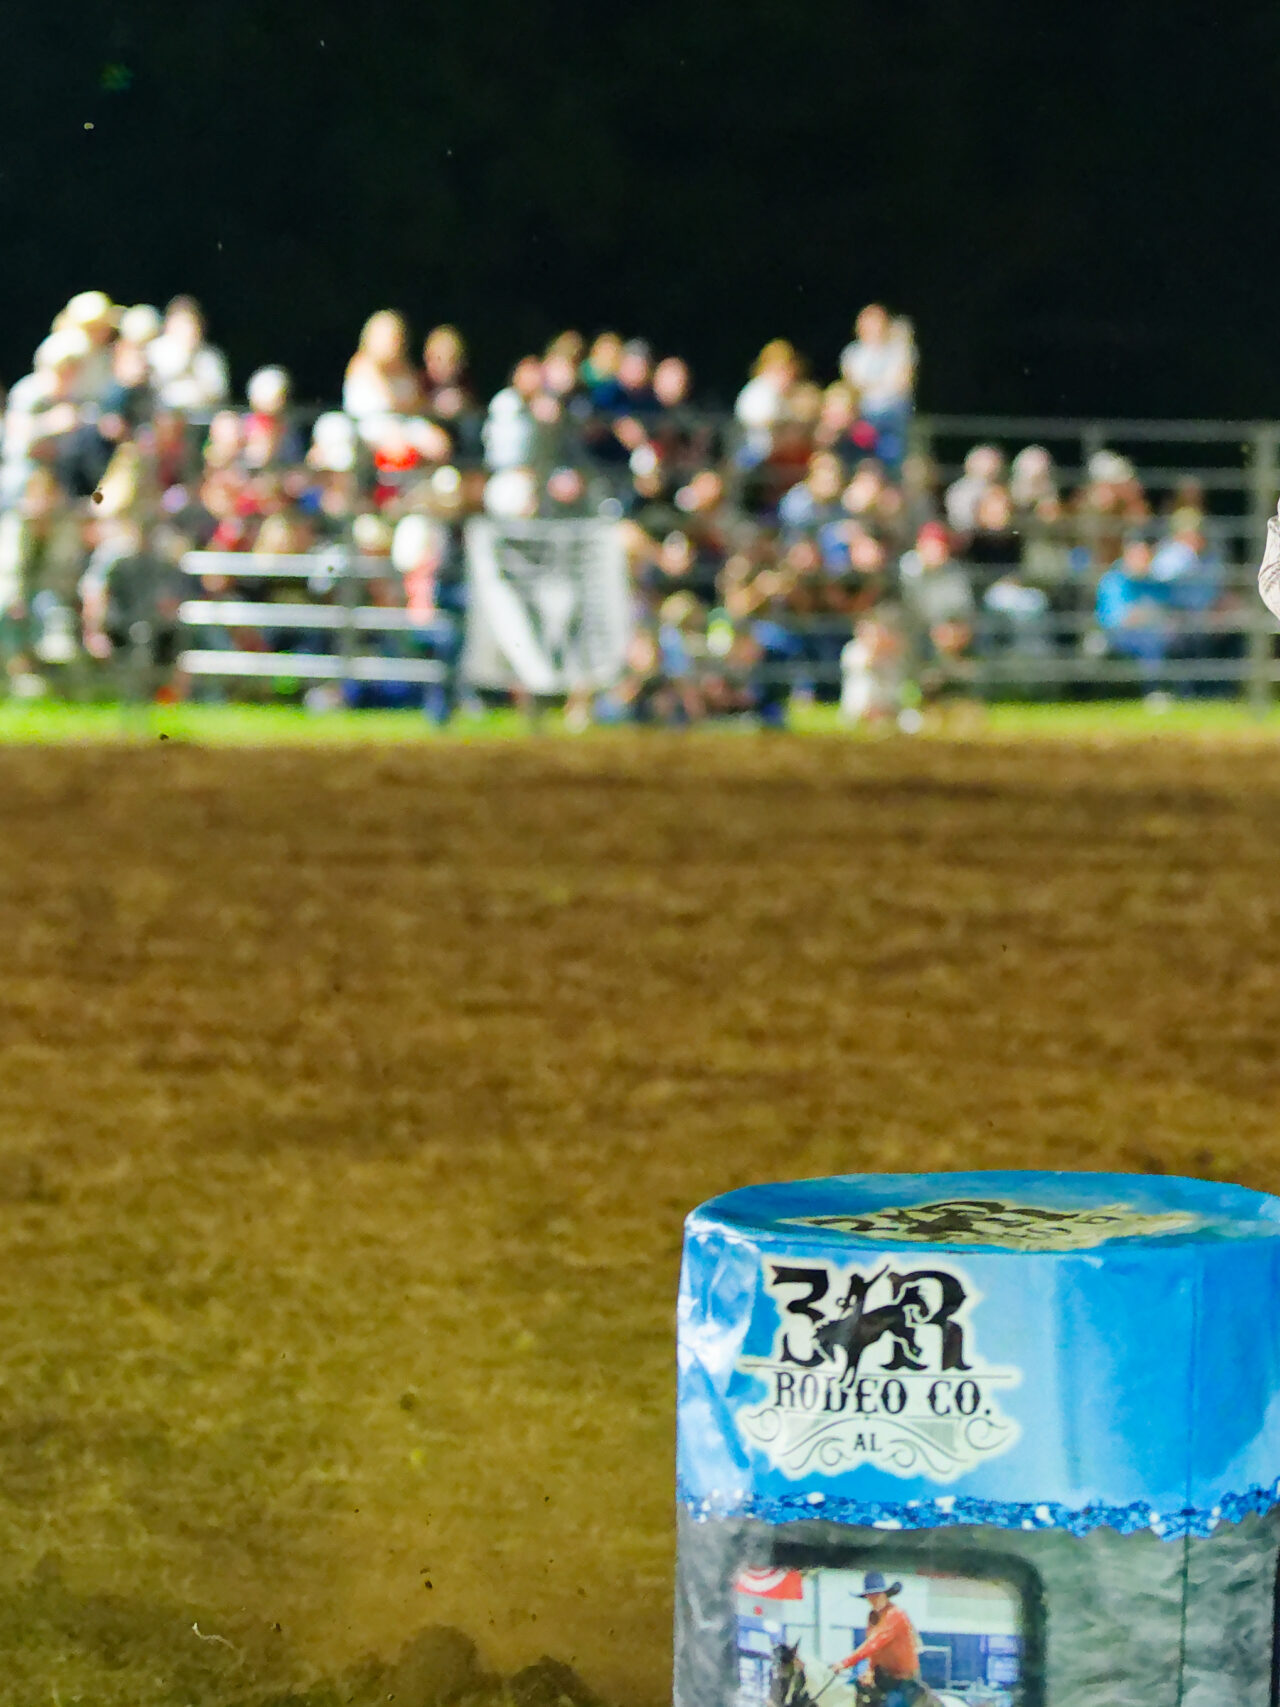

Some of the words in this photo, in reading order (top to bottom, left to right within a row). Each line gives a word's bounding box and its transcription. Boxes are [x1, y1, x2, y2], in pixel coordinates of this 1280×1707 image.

[774, 1371, 907, 1414] RODEO
[928, 1380, 991, 1416] CO.
[853, 1432, 882, 1452] AL
